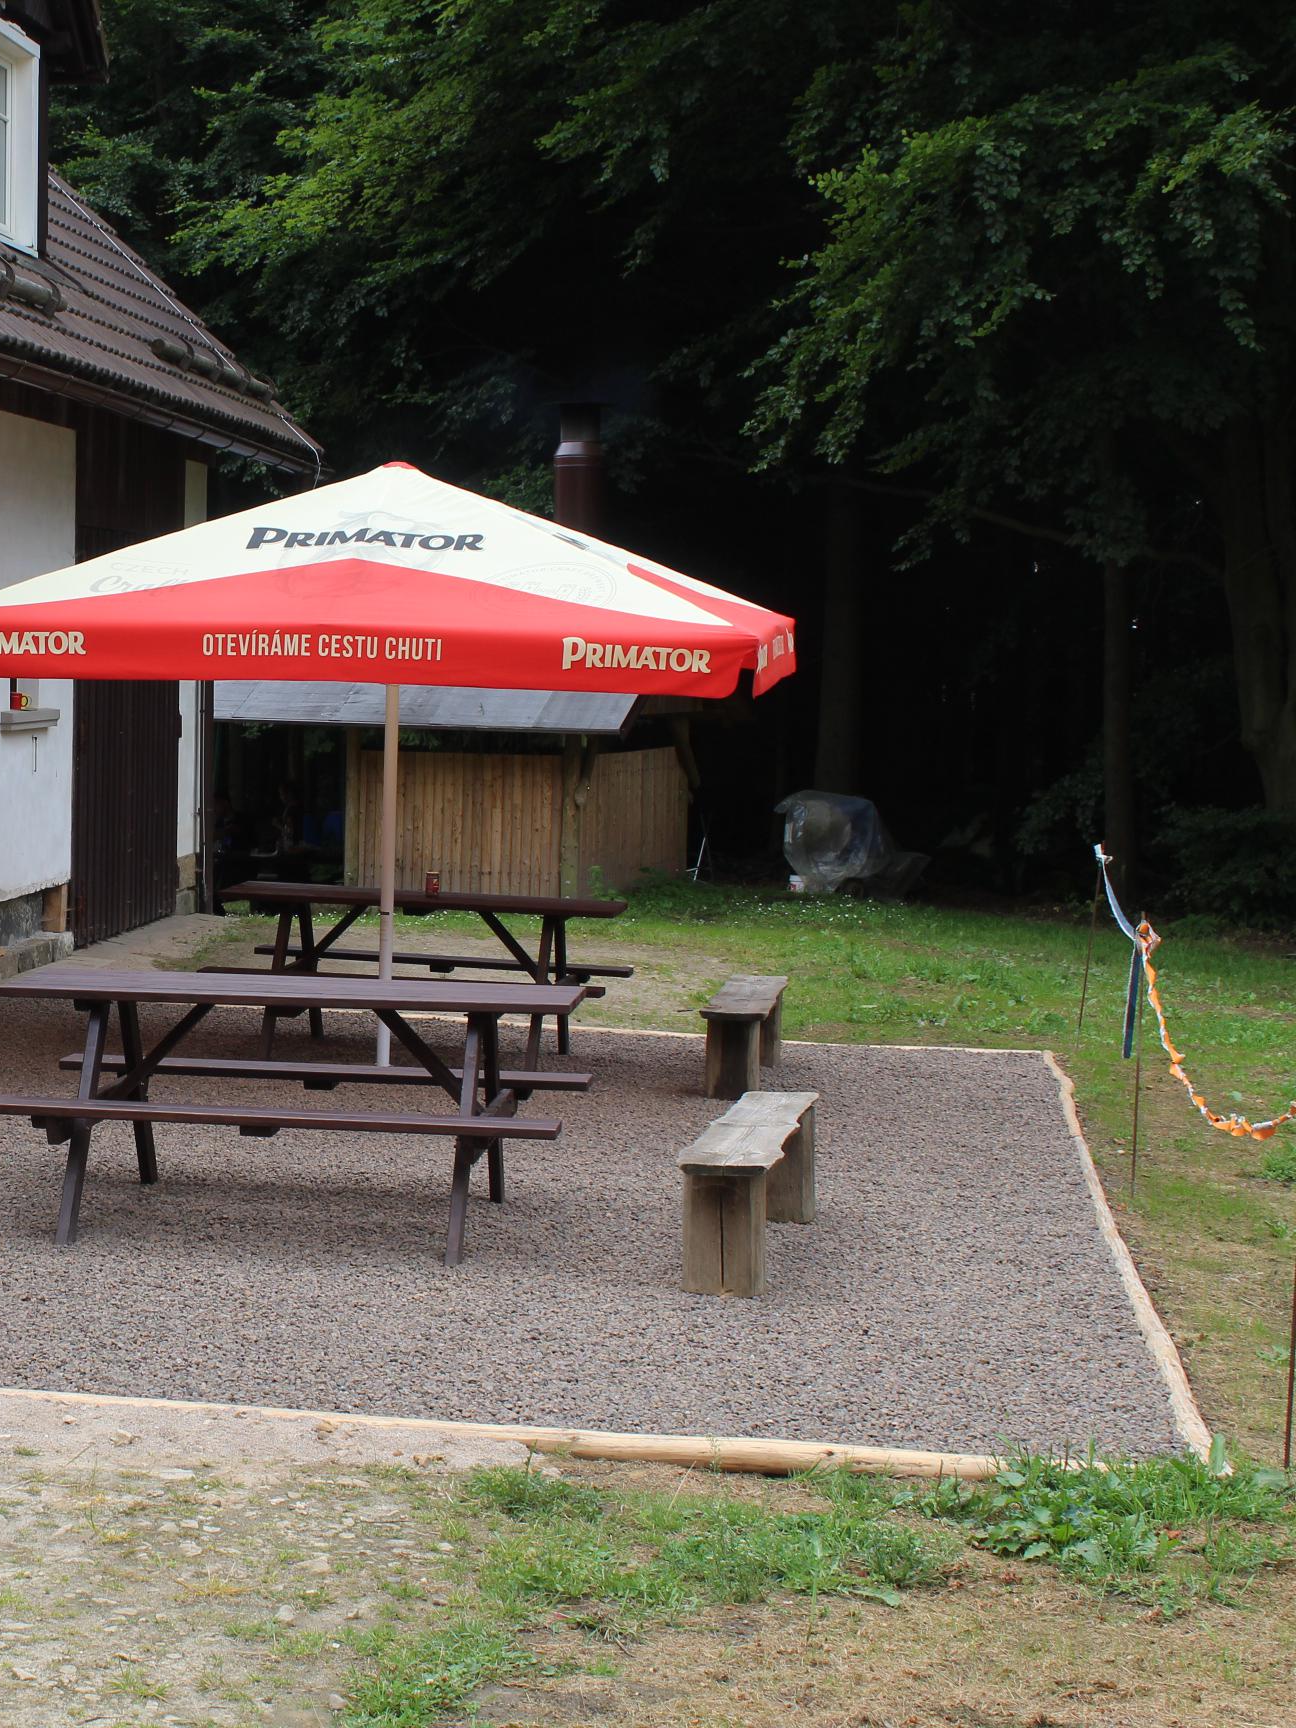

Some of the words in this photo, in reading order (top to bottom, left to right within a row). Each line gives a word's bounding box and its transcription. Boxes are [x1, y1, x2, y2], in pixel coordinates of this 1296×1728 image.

[246, 527, 485, 551] PRIMATOR
[110, 562, 190, 576] CZECH
[202, 629, 312, 657] OTEVÍRÁME
[318, 634, 379, 659] CESTU
[385, 636, 443, 661] CHUTI
[562, 636, 712, 674] PRIMATOR
